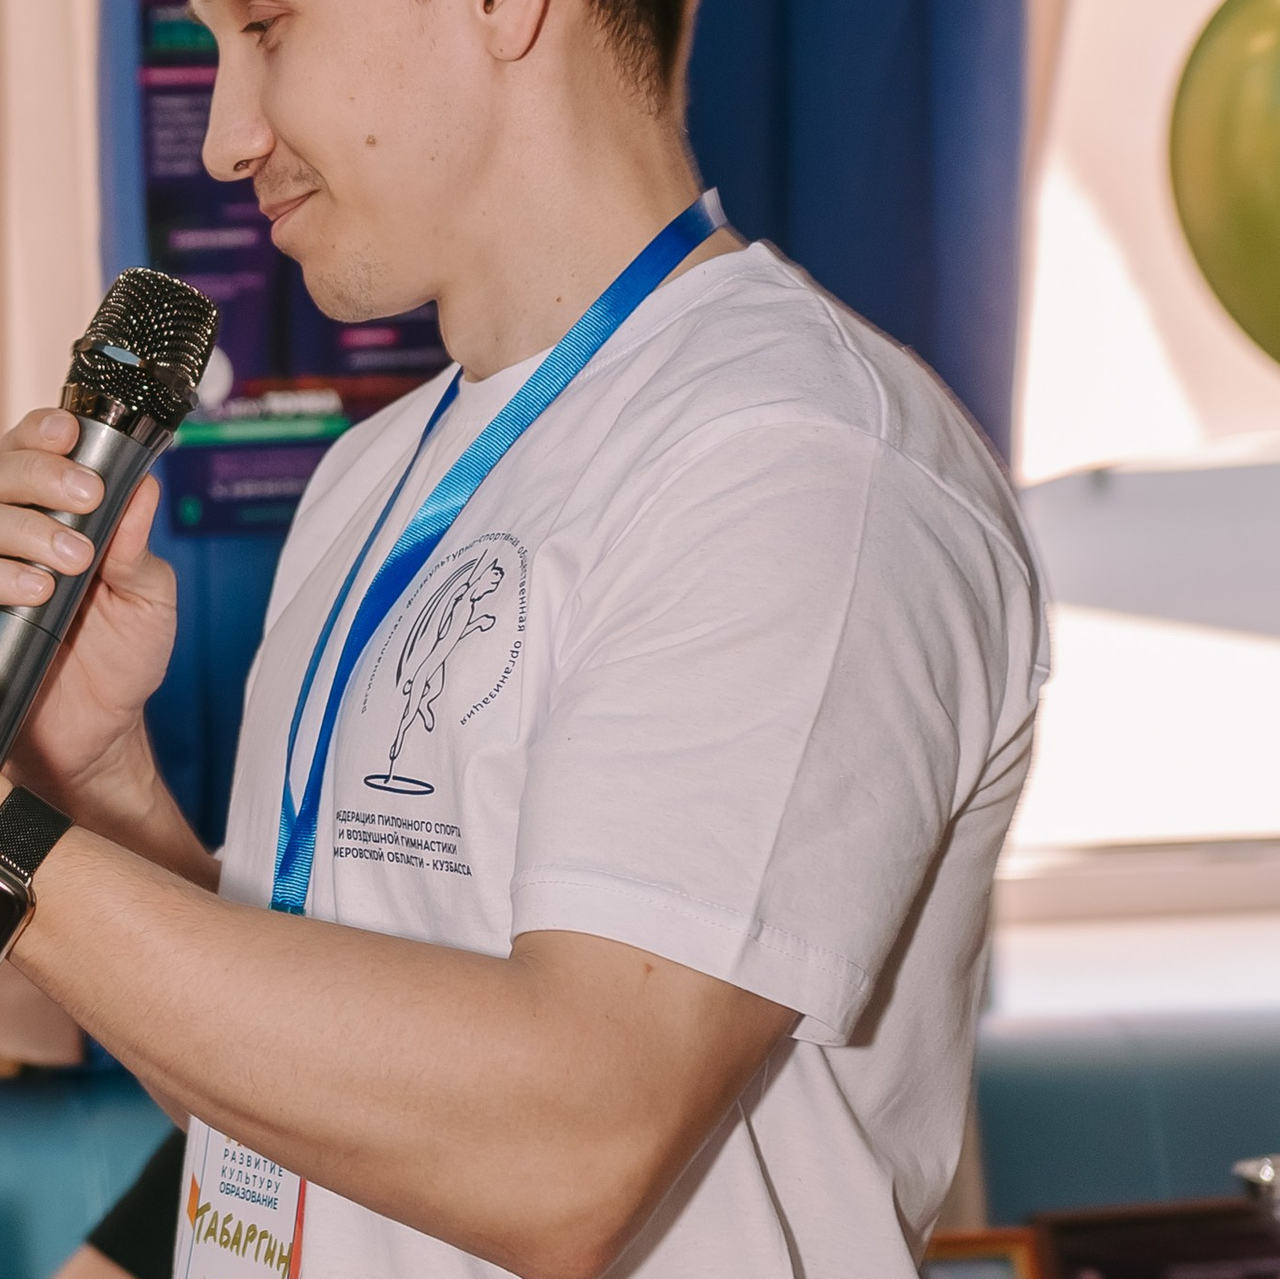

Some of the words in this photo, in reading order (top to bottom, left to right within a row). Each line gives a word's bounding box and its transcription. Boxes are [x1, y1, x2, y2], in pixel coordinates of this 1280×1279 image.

[460, 640, 522, 726] организация
[377, 814, 433, 834] ПИЛОННОГО
[434, 822, 462, 839] СПОРТА
[338, 828, 346, 840] И
[347, 829, 400, 845] ВОЗДУШНОЙ
[401, 835, 458, 855] ГИМНАСТИКИ
[387, 851, 424, 869] ОБЛАСТИ
[432, 858, 472, 877] КУЗБАССА
[223, 1148, 283, 1177] РАЗВИТИЕ
[220, 1165, 281, 1194] КУЛЬТУРУ
[219, 1181, 279, 1210] ОБРАЗОВАНИЕ
